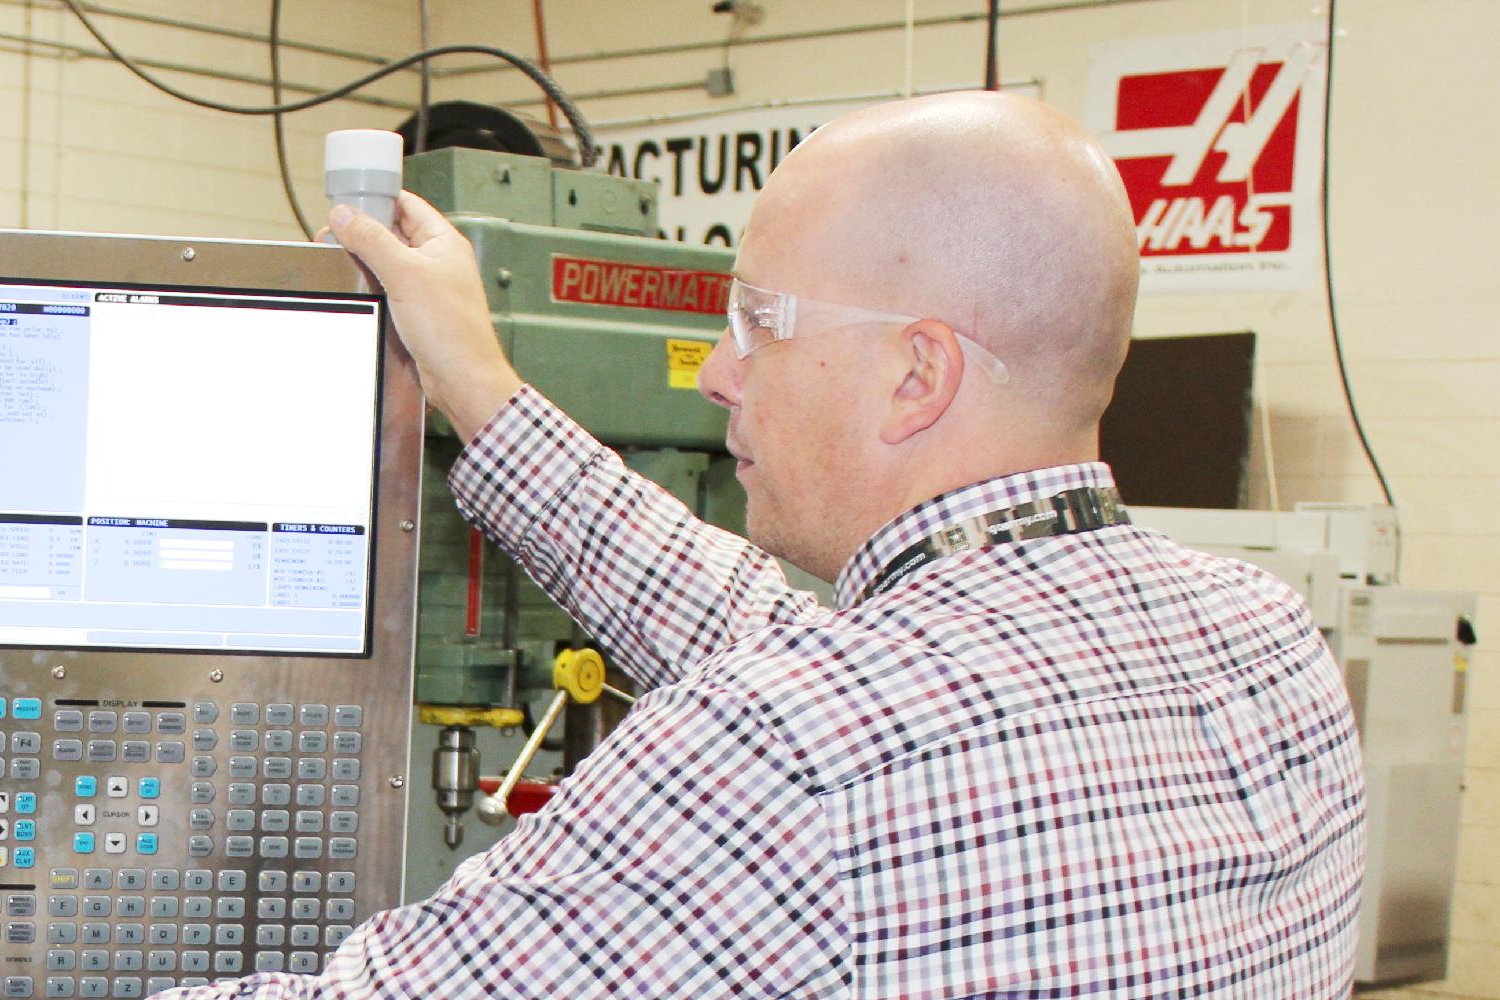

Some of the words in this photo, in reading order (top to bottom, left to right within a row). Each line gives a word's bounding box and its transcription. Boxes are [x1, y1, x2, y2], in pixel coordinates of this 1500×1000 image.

[1137, 195, 1290, 250] HAAS
[98, 294, 128, 302] ACTIVE
[988, 510, 1058, 535] goarmy.com
[280, 524, 308, 532] TIMERS
[319, 525, 356, 534] COUNTERS
[20, 739, 32, 747] F4
[52, 875, 77, 883] SHIFT
[94, 875, 102, 884] A
[127, 875, 135, 884] B
[161, 875, 169, 885] C
[195, 876, 203, 885] D
[229, 876, 236, 885] E
[269, 877, 277, 886] 7
[304, 878, 311, 886] 8
[339, 878, 346, 887] 9
[59, 901, 67, 910] F
[93, 902, 101, 911] G
[127, 903, 135, 912] H
[162, 903, 167, 912] I
[195, 903, 202, 912] J
[228, 904, 235, 912] K
[268, 903, 276, 912] 4
[303, 904, 310, 913] 5
[338, 904, 345, 914] 6
[59, 929, 65, 938] L
[92, 929, 100, 938] M
[126, 930, 134, 939] N
[159, 930, 168, 939] O
[193, 930, 201, 939] P
[226, 930, 235, 940] Q
[268, 931, 274, 939] 1
[302, 931, 309, 940] 2
[337, 931, 344, 940] 3
[57, 956, 65, 965] R
[92, 956, 100, 965] S
[125, 957, 132, 965] T
[159, 957, 167, 966] U
[192, 958, 200, 966] V
[225, 958, 235, 967] W
[301, 958, 308, 968] 0
[56, 983, 64, 993] X
[91, 983, 99, 993] Y
[125, 984, 132, 993] Z
